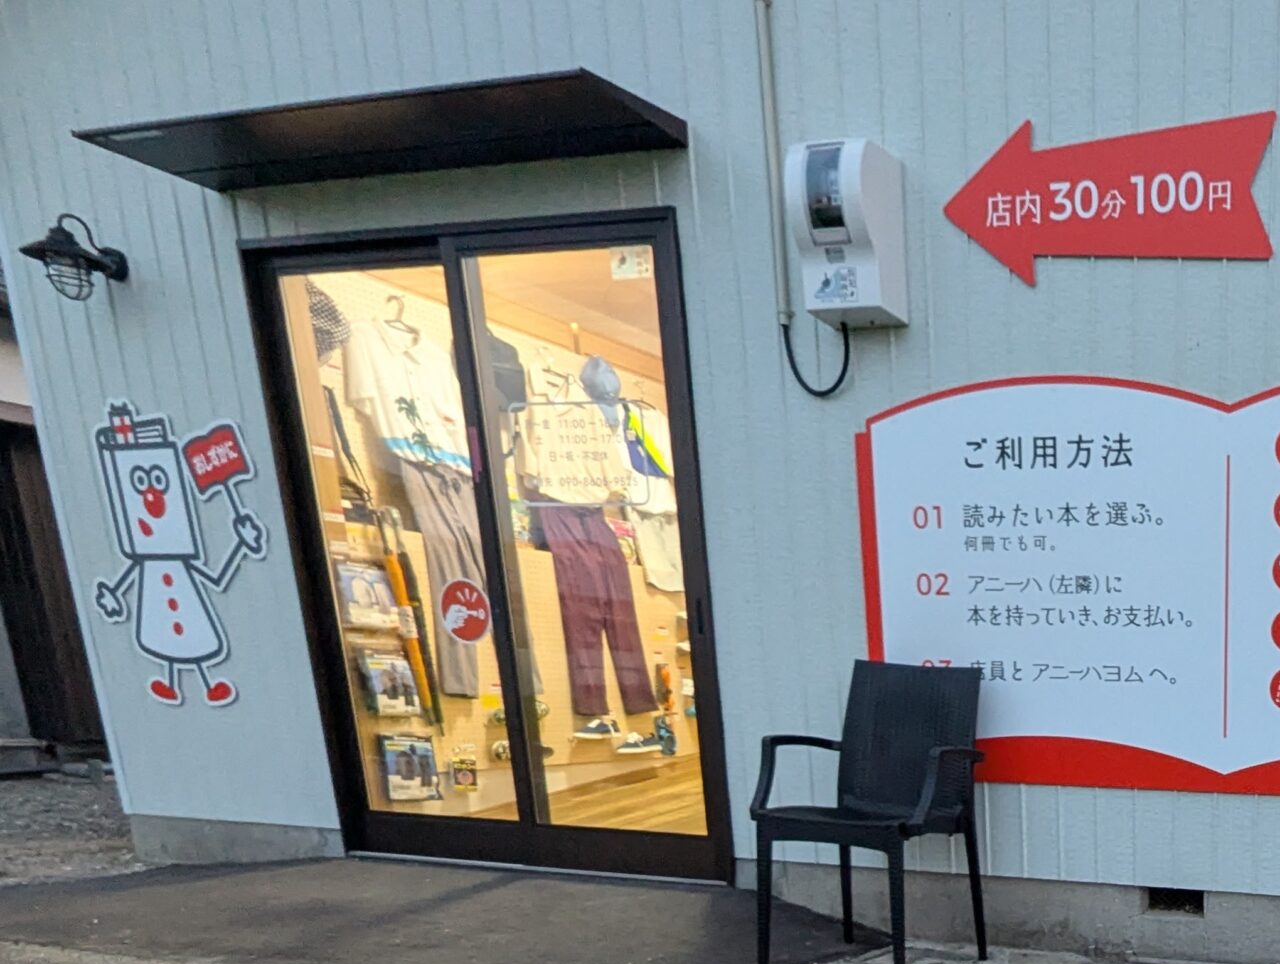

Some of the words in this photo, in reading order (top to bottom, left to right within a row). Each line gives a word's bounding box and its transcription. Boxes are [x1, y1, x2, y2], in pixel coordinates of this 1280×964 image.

[986, 171, 1232, 228] 店内30分100円
[964, 432, 1133, 470] ご利用方法
[913, 505, 943, 529] 01
[962, 501, 1164, 528] 読みたい本を選ぶ。
[963, 535, 1056, 552] 何冊でも可。
[916, 573, 950, 596] 02
[966, 604, 1193, 628] 本を持っていき、お支払い。
